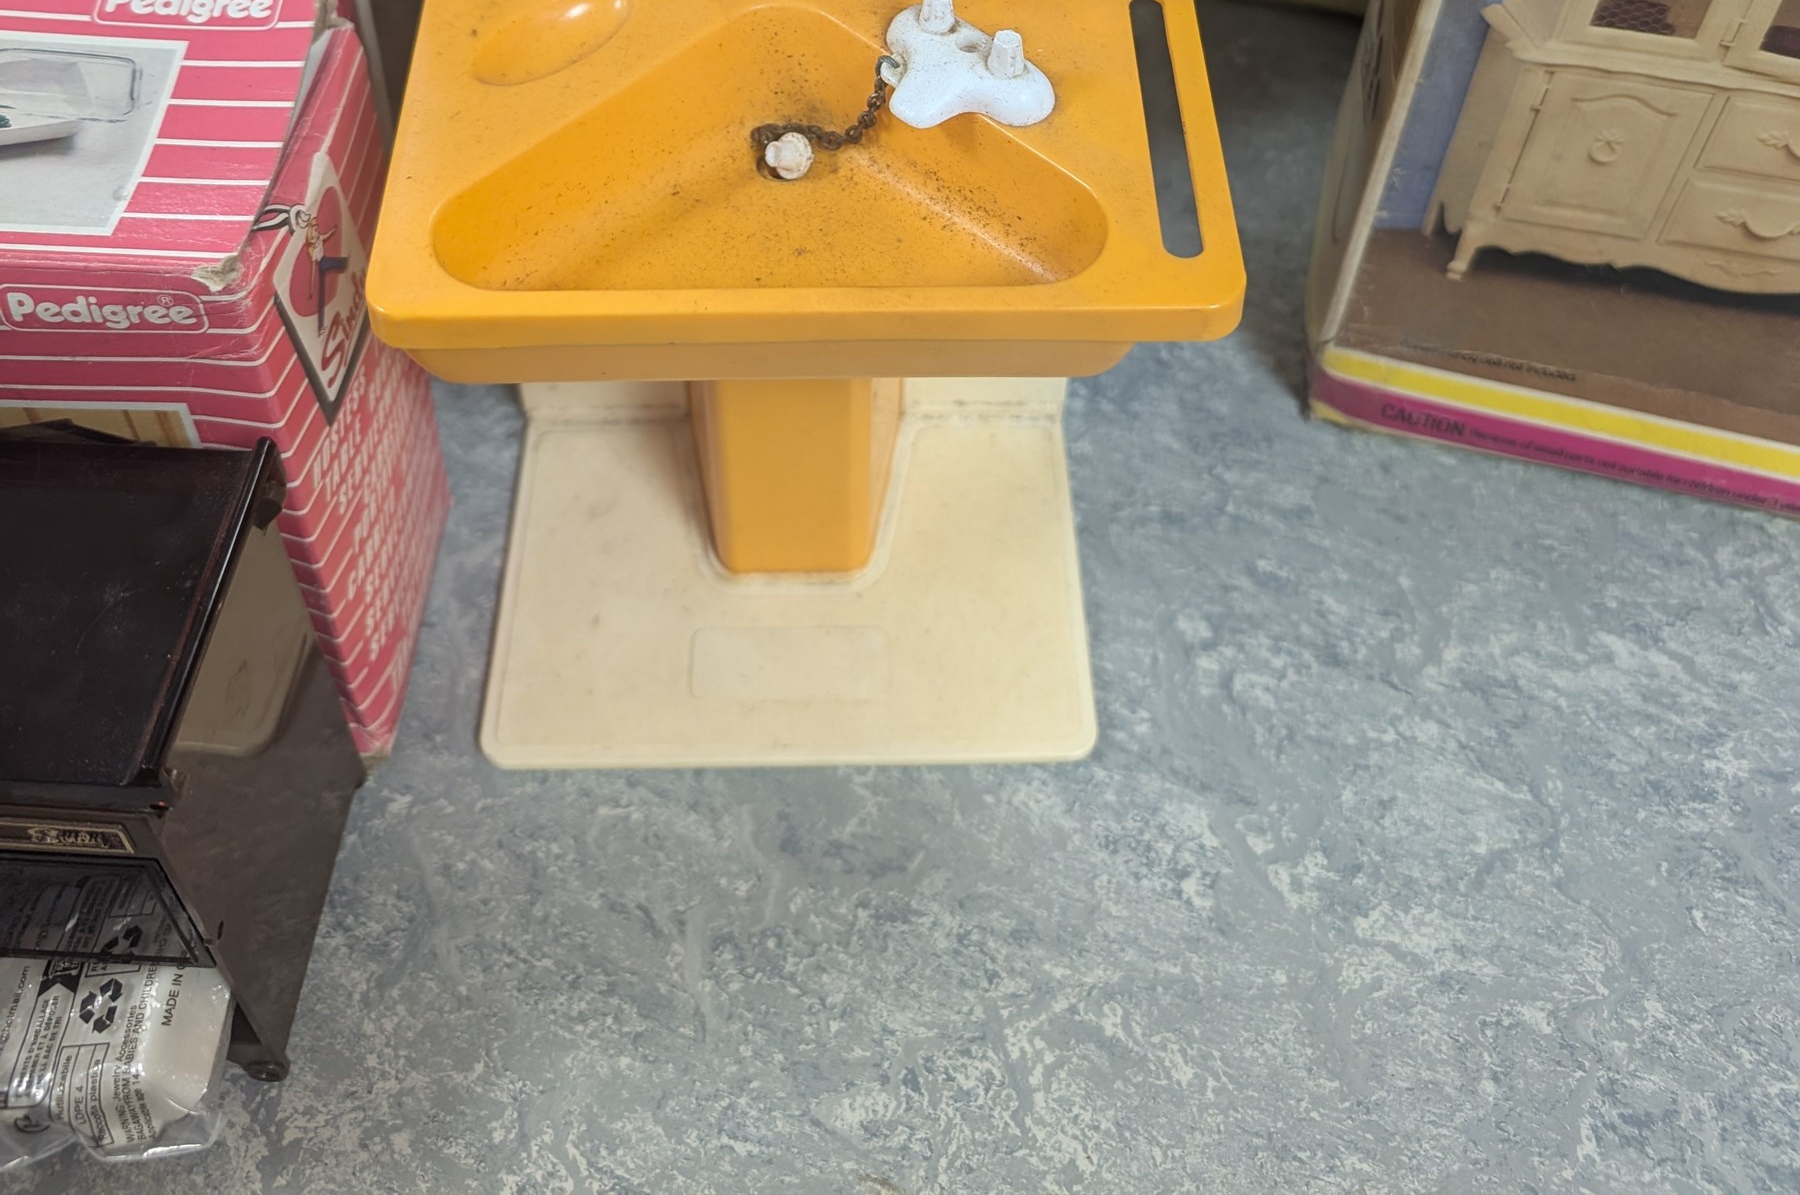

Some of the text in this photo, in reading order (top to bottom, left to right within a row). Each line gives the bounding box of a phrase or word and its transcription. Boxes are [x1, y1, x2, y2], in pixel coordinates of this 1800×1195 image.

[6, 292, 198, 329] Pedigree
[1380, 401, 1466, 437] CAUTION
[161, 989, 180, 1026] MADE
[173, 973, 185, 986] IN
[116, 1004, 138, 1062] Accessories
[132, 1014, 144, 1036] AND
[113, 1065, 122, 1102] Jewelry
[74, 1085, 87, 1125] LDPE 4
